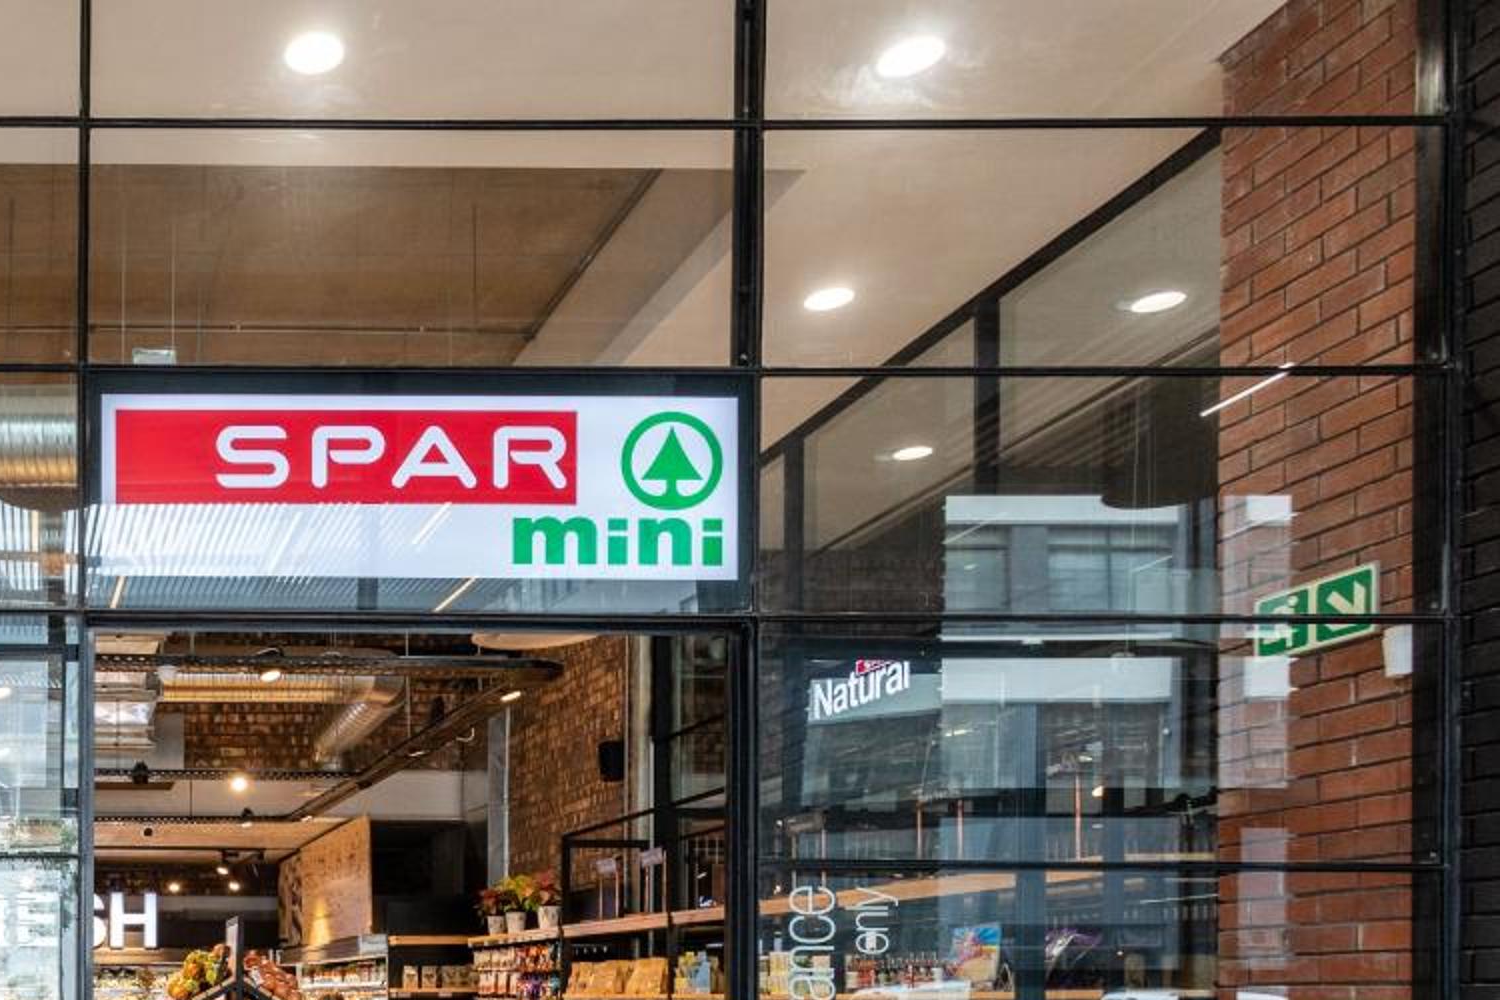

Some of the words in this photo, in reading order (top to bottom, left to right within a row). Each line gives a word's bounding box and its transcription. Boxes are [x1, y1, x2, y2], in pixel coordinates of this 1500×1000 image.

[215, 425, 568, 489] SPAR
[511, 516, 725, 567] mini
[813, 661, 911, 720] Natural
[855, 887, 899, 955] only
